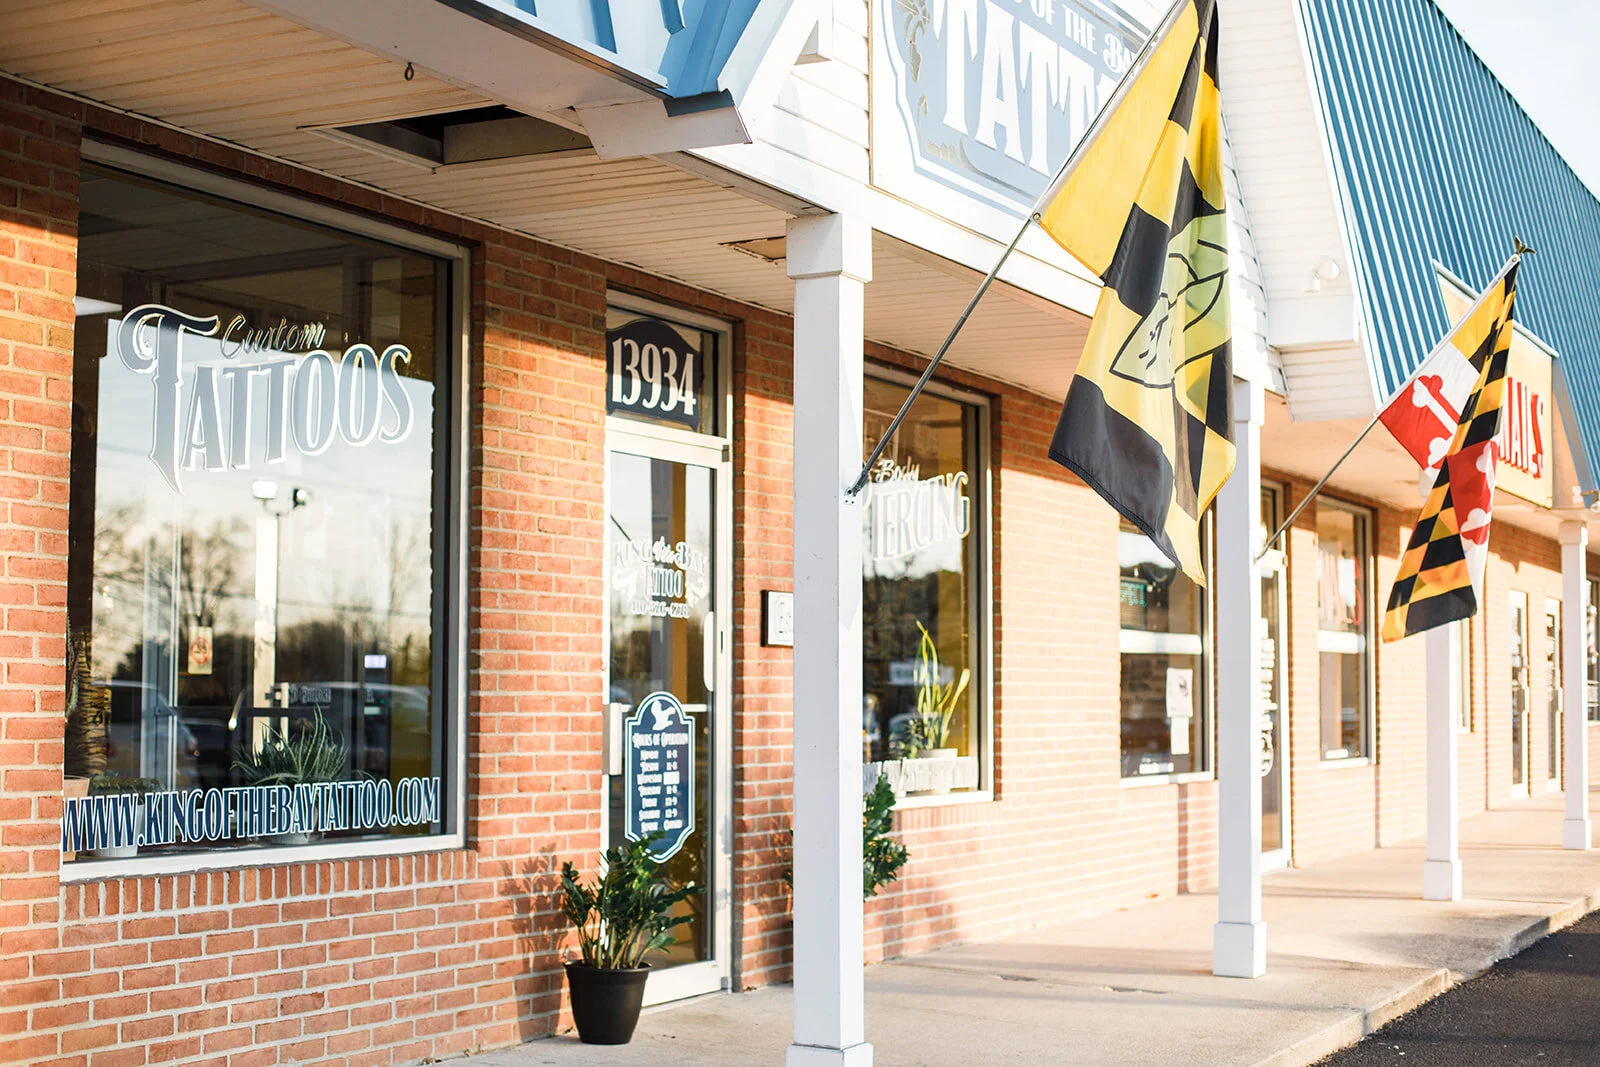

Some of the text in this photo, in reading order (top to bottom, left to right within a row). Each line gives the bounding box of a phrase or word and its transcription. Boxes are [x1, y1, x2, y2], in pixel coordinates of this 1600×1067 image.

[1062, 4, 1098, 56] THE
[219, 312, 327, 359] Custom
[117, 303, 415, 496] TATTOOS
[612, 337, 697, 416] 13934
[876, 455, 920, 484] Body
[612, 540, 653, 569] KING
[674, 541, 709, 577] BAY
[63, 776, 441, 852] WWW.KINGOFTHEBAYTATTOO.COM
